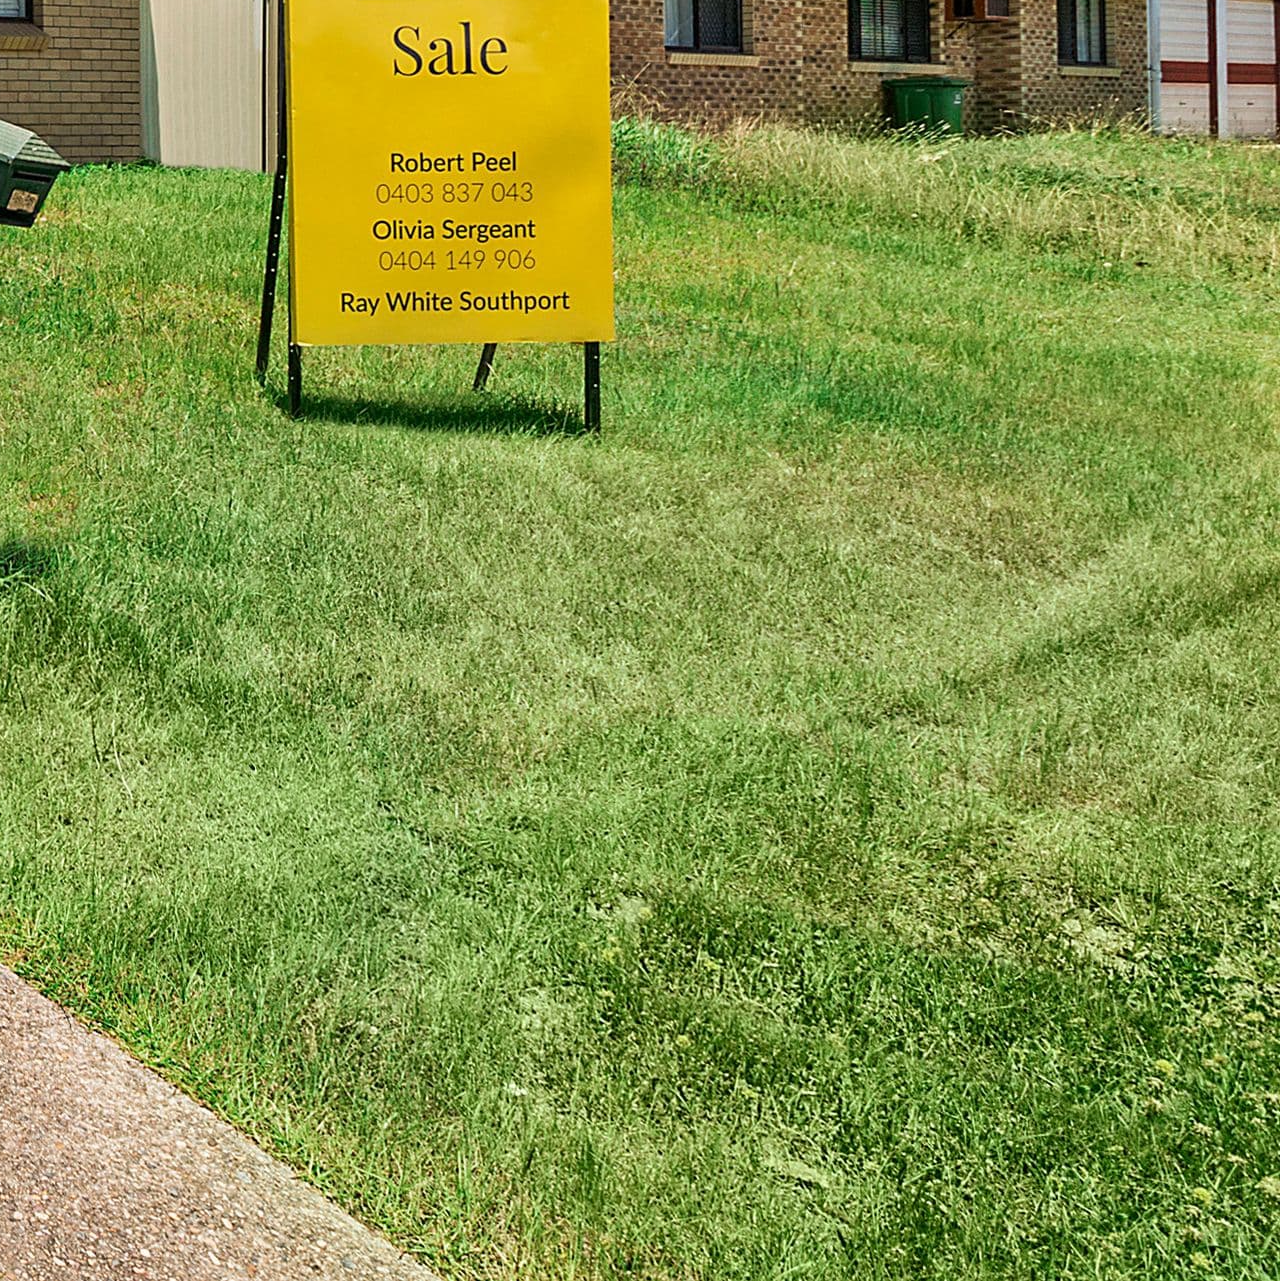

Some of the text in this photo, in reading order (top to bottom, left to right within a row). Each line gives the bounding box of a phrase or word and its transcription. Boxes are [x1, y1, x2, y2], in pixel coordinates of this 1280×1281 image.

[393, 22, 508, 76] Sale
[391, 151, 517, 173] Robert Peel
[376, 182, 534, 204] 0403 837 043
[373, 220, 536, 243] Olivia Sergeant
[378, 249, 536, 272] 0404 149 906
[341, 290, 570, 315] Ray White Southport
